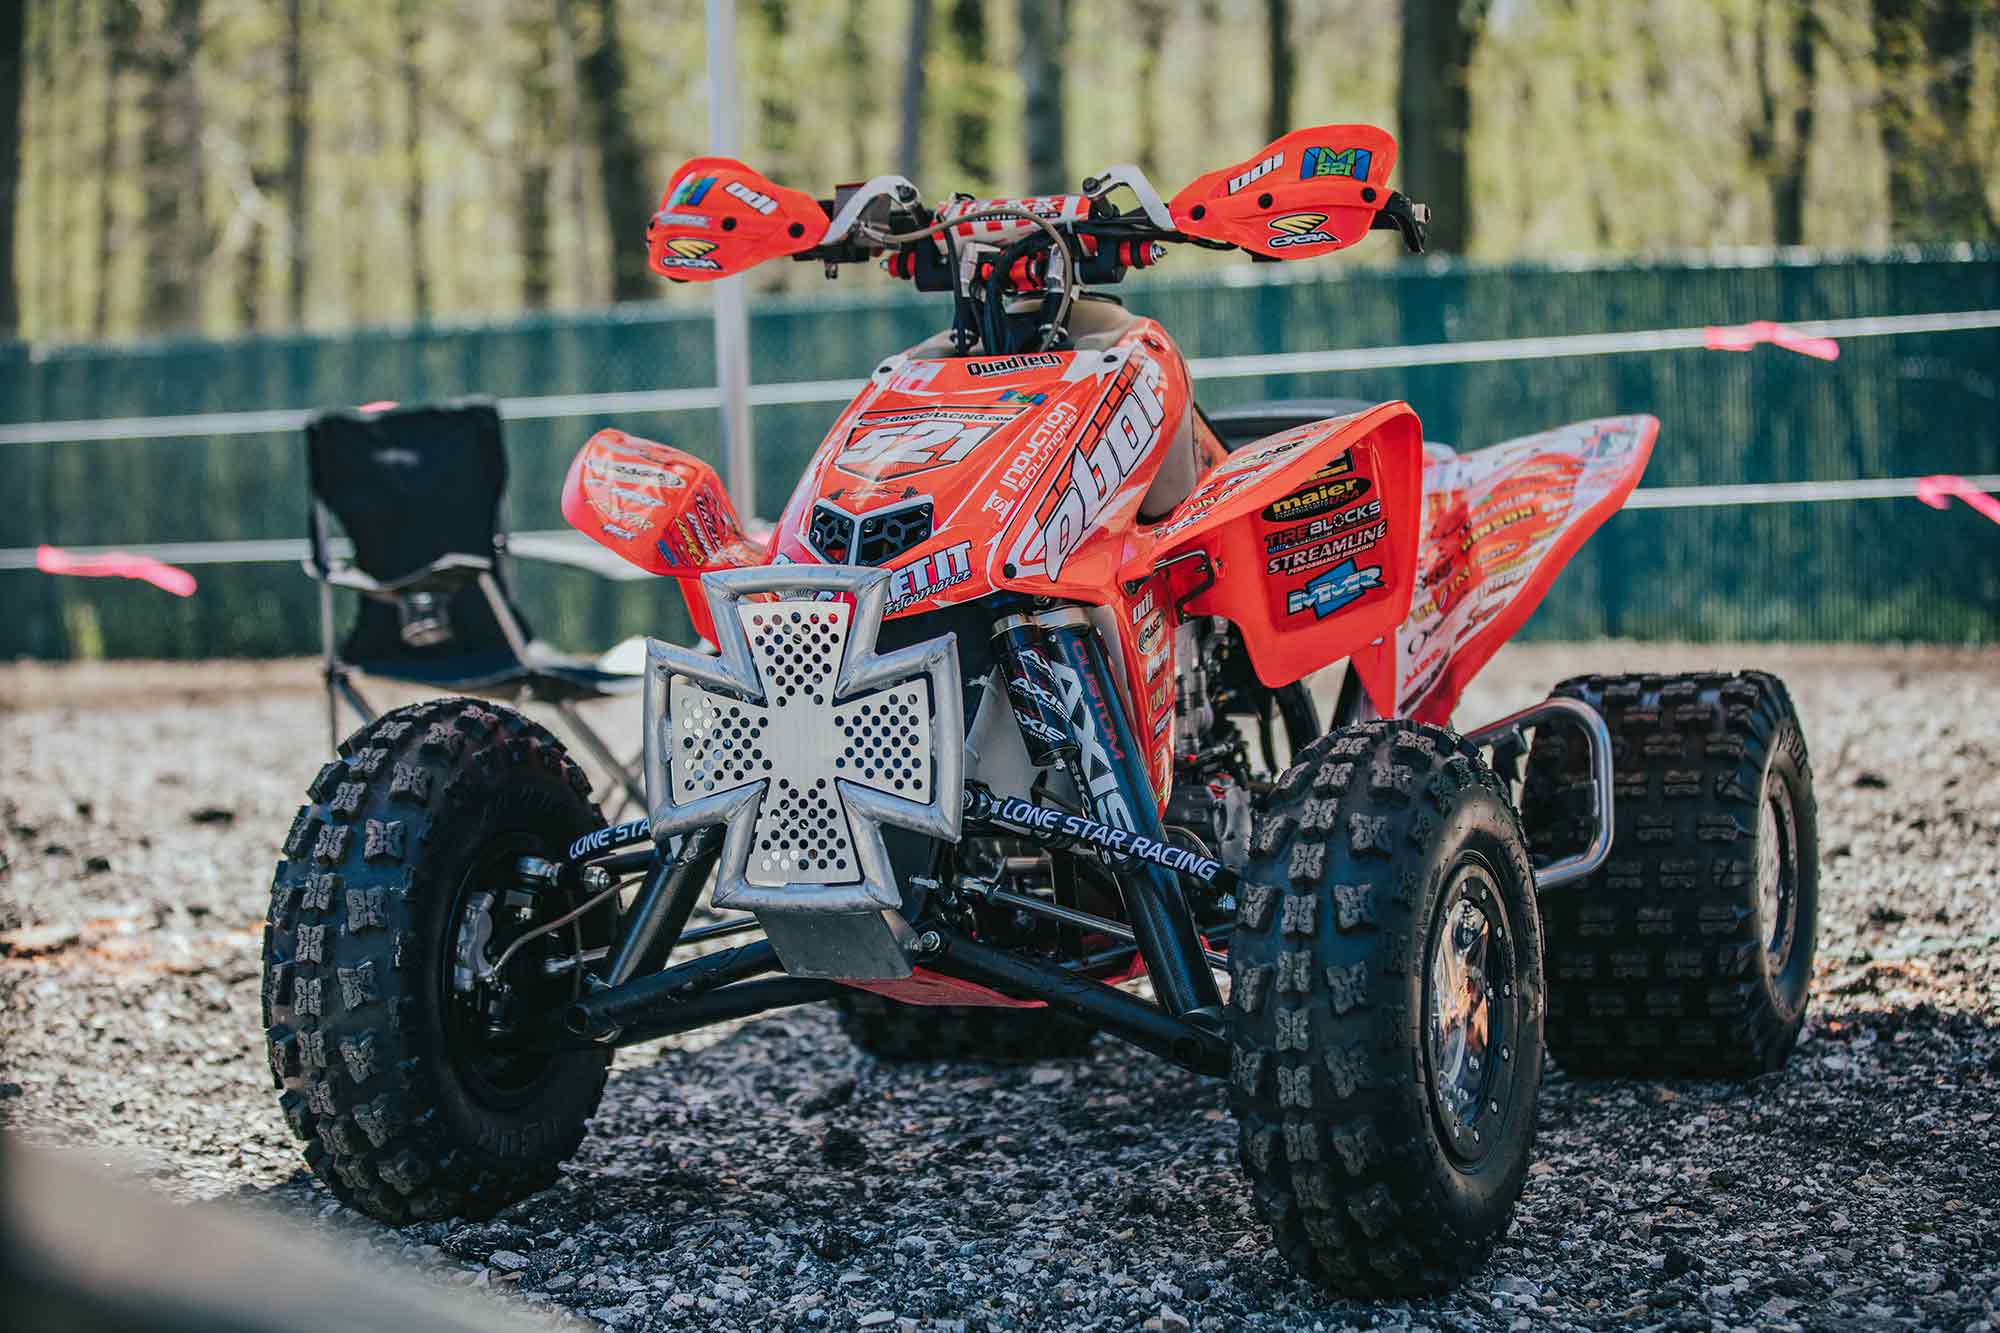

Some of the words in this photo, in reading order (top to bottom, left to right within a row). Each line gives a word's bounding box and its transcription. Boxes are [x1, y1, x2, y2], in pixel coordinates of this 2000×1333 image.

[834, 420, 993, 465] 521
[1019, 414, 1077, 490] SOLUTIONS
[1273, 479, 1357, 513] maier
[1268, 521, 1387, 574] STREAMLINE
[1072, 640, 1124, 759] CUSTOM
[569, 827, 611, 859] LONE
[1002, 799, 1063, 830] LONE
[1062, 816, 1128, 850] STAR
[1129, 836, 1222, 881] RACING
